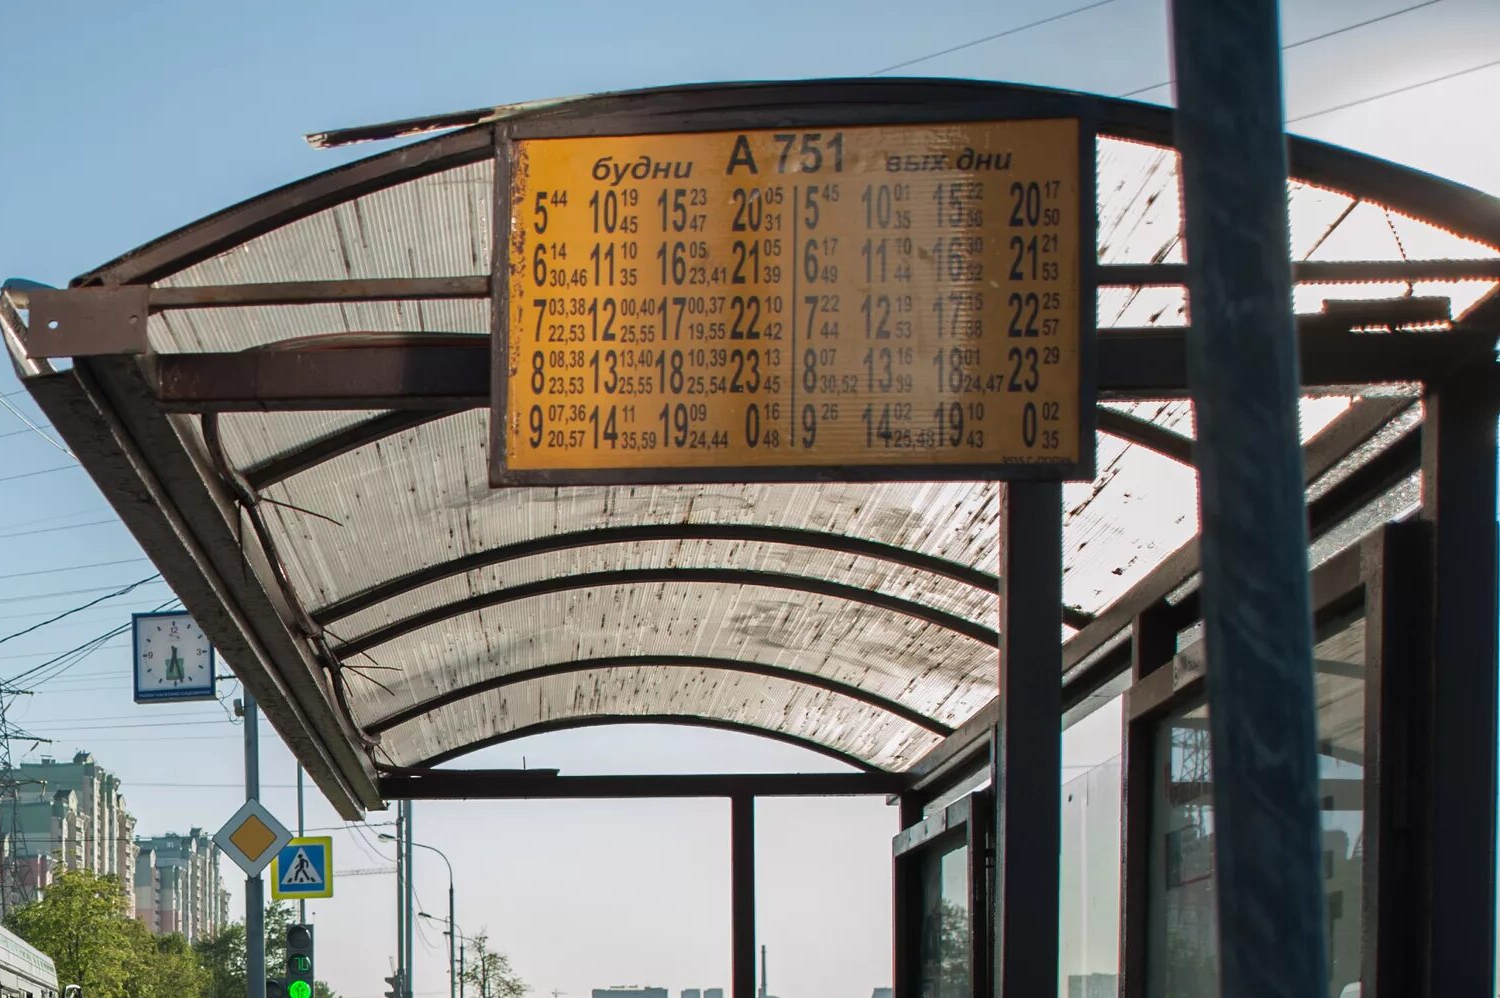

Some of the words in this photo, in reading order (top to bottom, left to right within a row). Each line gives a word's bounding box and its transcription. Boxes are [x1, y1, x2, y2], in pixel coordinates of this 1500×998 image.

[592, 156, 693, 186] будни
[773, 132, 843, 174] 751
[534, 192, 548, 234] 5
[550, 190, 568, 207] 44
[589, 189, 618, 233] 10
[621, 189, 638, 207] 19
[658, 189, 687, 232] 15
[690, 189, 707, 206] 23
[731, 188, 763, 232] 20
[765, 187, 783, 205] 05
[620, 216, 638, 233] 45
[689, 215, 707, 232] 47
[765, 213, 782, 231] 31
[805, 186, 819, 229] 5
[822, 184, 840, 202] 45
[862, 184, 891, 229] 10
[933, 183, 962, 228] 15
[1009, 182, 1041, 227] 20
[1045, 181, 1060, 198] 17
[1043, 209, 1060, 226] 50
[533, 243, 547, 287] 6
[551, 243, 567, 260] 14
[590, 243, 614, 286] 11
[621, 242, 638, 260] 10
[657, 242, 687, 286] 16
[689, 242, 707, 259] 05
[731, 240, 759, 285] 21
[763, 239, 781, 257] 05
[804, 239, 818, 283] 6
[822, 238, 839, 256] 17
[862, 238, 886, 283] 11
[1009, 236, 1037, 281] 21
[1042, 235, 1058, 252] 21
[821, 266, 838, 283] 49
[1042, 263, 1059, 281] 53
[550, 269, 587, 290] 30,46
[620, 268, 637, 286] 35
[689, 268, 727, 288] 23,41
[763, 266, 781, 284] 39
[533, 299, 547, 342] 7
[549, 298, 585, 319] 03,38
[588, 298, 617, 341] 12
[621, 298, 655, 318] 00,40
[657, 297, 687, 341] 17
[688, 297, 726, 317] 00,37
[730, 296, 761, 340] 22
[765, 296, 783, 313] 10
[805, 295, 819, 339] 7
[821, 295, 840, 313] 22
[861, 295, 891, 339] 12
[1008, 293, 1039, 337] 22
[1043, 292, 1060, 310] 25
[820, 322, 840, 339] 44
[1042, 319, 1059, 336] 57
[548, 325, 585, 345] 22,53
[620, 325, 655, 345] 25,55
[688, 323, 726, 343] 19,55
[764, 323, 782, 340] 42
[531, 351, 545, 394] 8
[550, 350, 584, 371] 08,38
[589, 350, 617, 394] 13
[620, 350, 653, 370] 13,40
[655, 350, 684, 394] 18
[688, 349, 727, 369] 10,39
[730, 349, 760, 394] 23
[764, 349, 780, 367] 13
[549, 377, 584, 397] 23,53
[619, 377, 653, 397] 25,55
[687, 376, 727, 397] 25,54
[764, 376, 781, 393] 45
[803, 348, 817, 393] 8
[820, 349, 837, 366] 07
[863, 348, 892, 393] 13
[933, 347, 963, 393] 18
[964, 350, 980, 366] 01
[1008, 347, 1039, 392] 23
[1044, 346, 1060, 364] 29
[820, 375, 858, 396] 30,52
[964, 374, 1004, 396] 24,47
[529, 404, 543, 448] 9
[549, 404, 586, 424] 07,36
[589, 404, 618, 448] 14
[622, 405, 635, 423] 11
[659, 403, 689, 447] 19
[690, 404, 707, 421] 09
[745, 403, 760, 448] 0
[765, 403, 780, 420] 16
[548, 431, 585, 451] 20,57
[621, 432, 657, 451] 35,59
[689, 431, 729, 451] 24,44
[763, 430, 780, 447] 48
[803, 404, 817, 448] 9
[821, 403, 839, 421] 26
[933, 402, 964, 447] 19
[967, 403, 984, 420] 10
[1022, 402, 1037, 447] 0
[1042, 402, 1059, 420] 02
[967, 430, 984, 448] 43
[1042, 431, 1059, 449] 35
